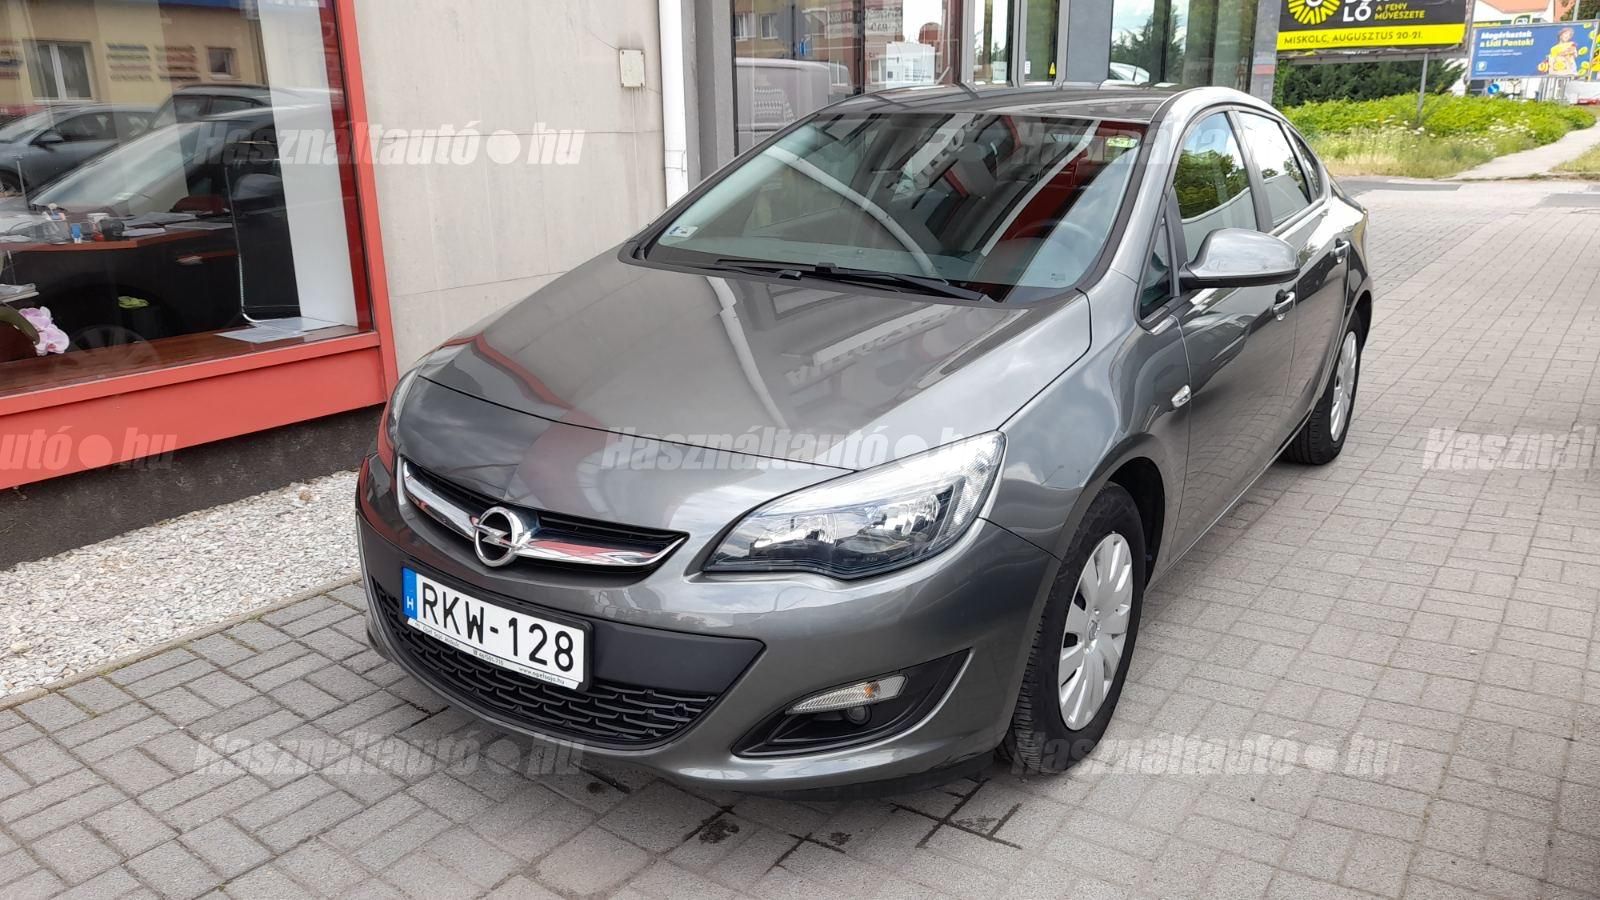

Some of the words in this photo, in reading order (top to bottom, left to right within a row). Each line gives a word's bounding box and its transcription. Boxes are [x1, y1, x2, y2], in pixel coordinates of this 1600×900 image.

[1332, 31, 1394, 42] AUGUSZTUS
[406, 596, 414, 611] H
[422, 581, 574, 672] RKW-128
